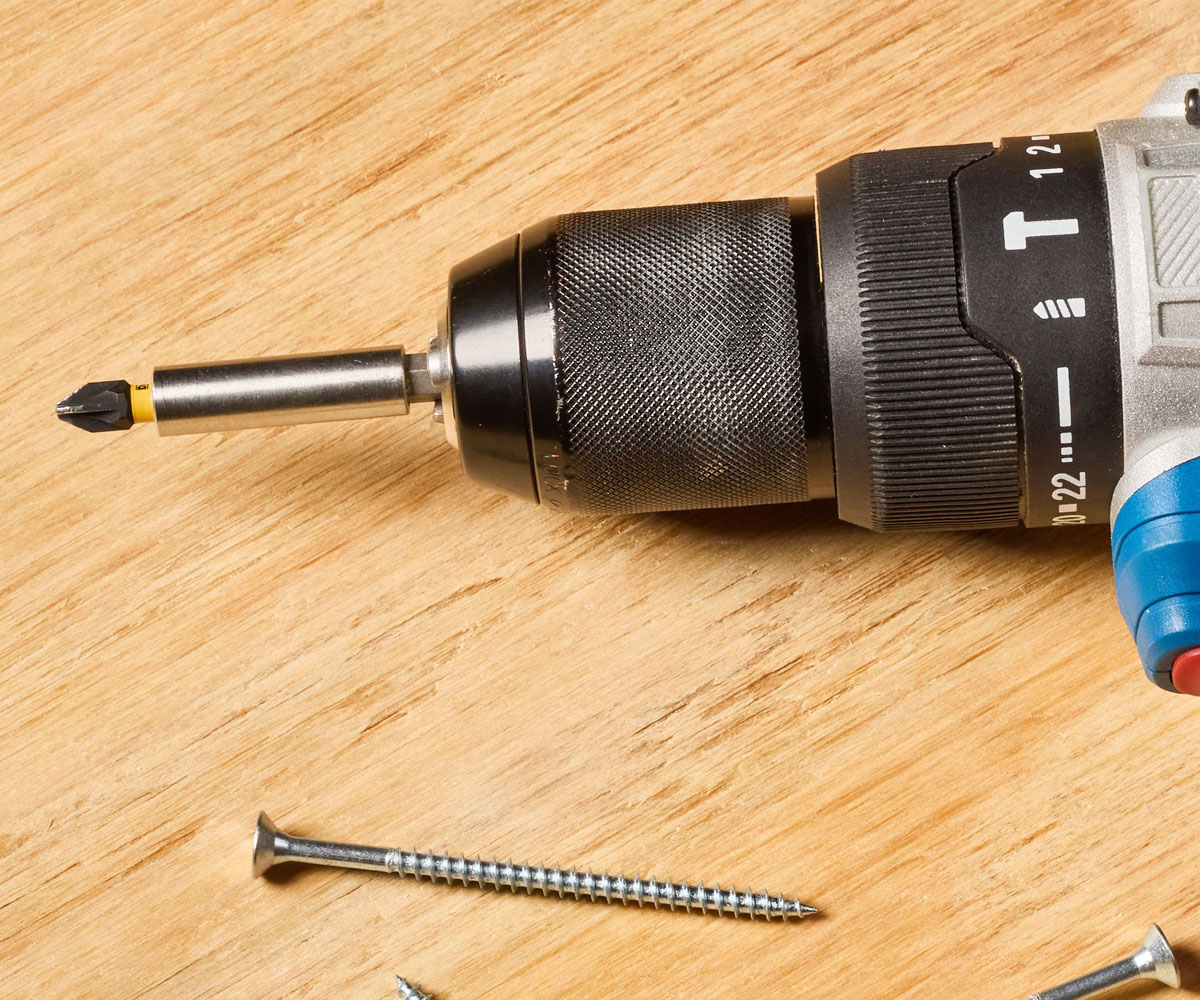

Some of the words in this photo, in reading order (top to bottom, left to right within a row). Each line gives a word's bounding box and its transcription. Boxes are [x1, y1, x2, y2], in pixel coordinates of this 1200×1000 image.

[1025, 144, 1061, 155] 2
[1029, 167, 1064, 179] 1
[1051, 471, 1087, 501] 22
